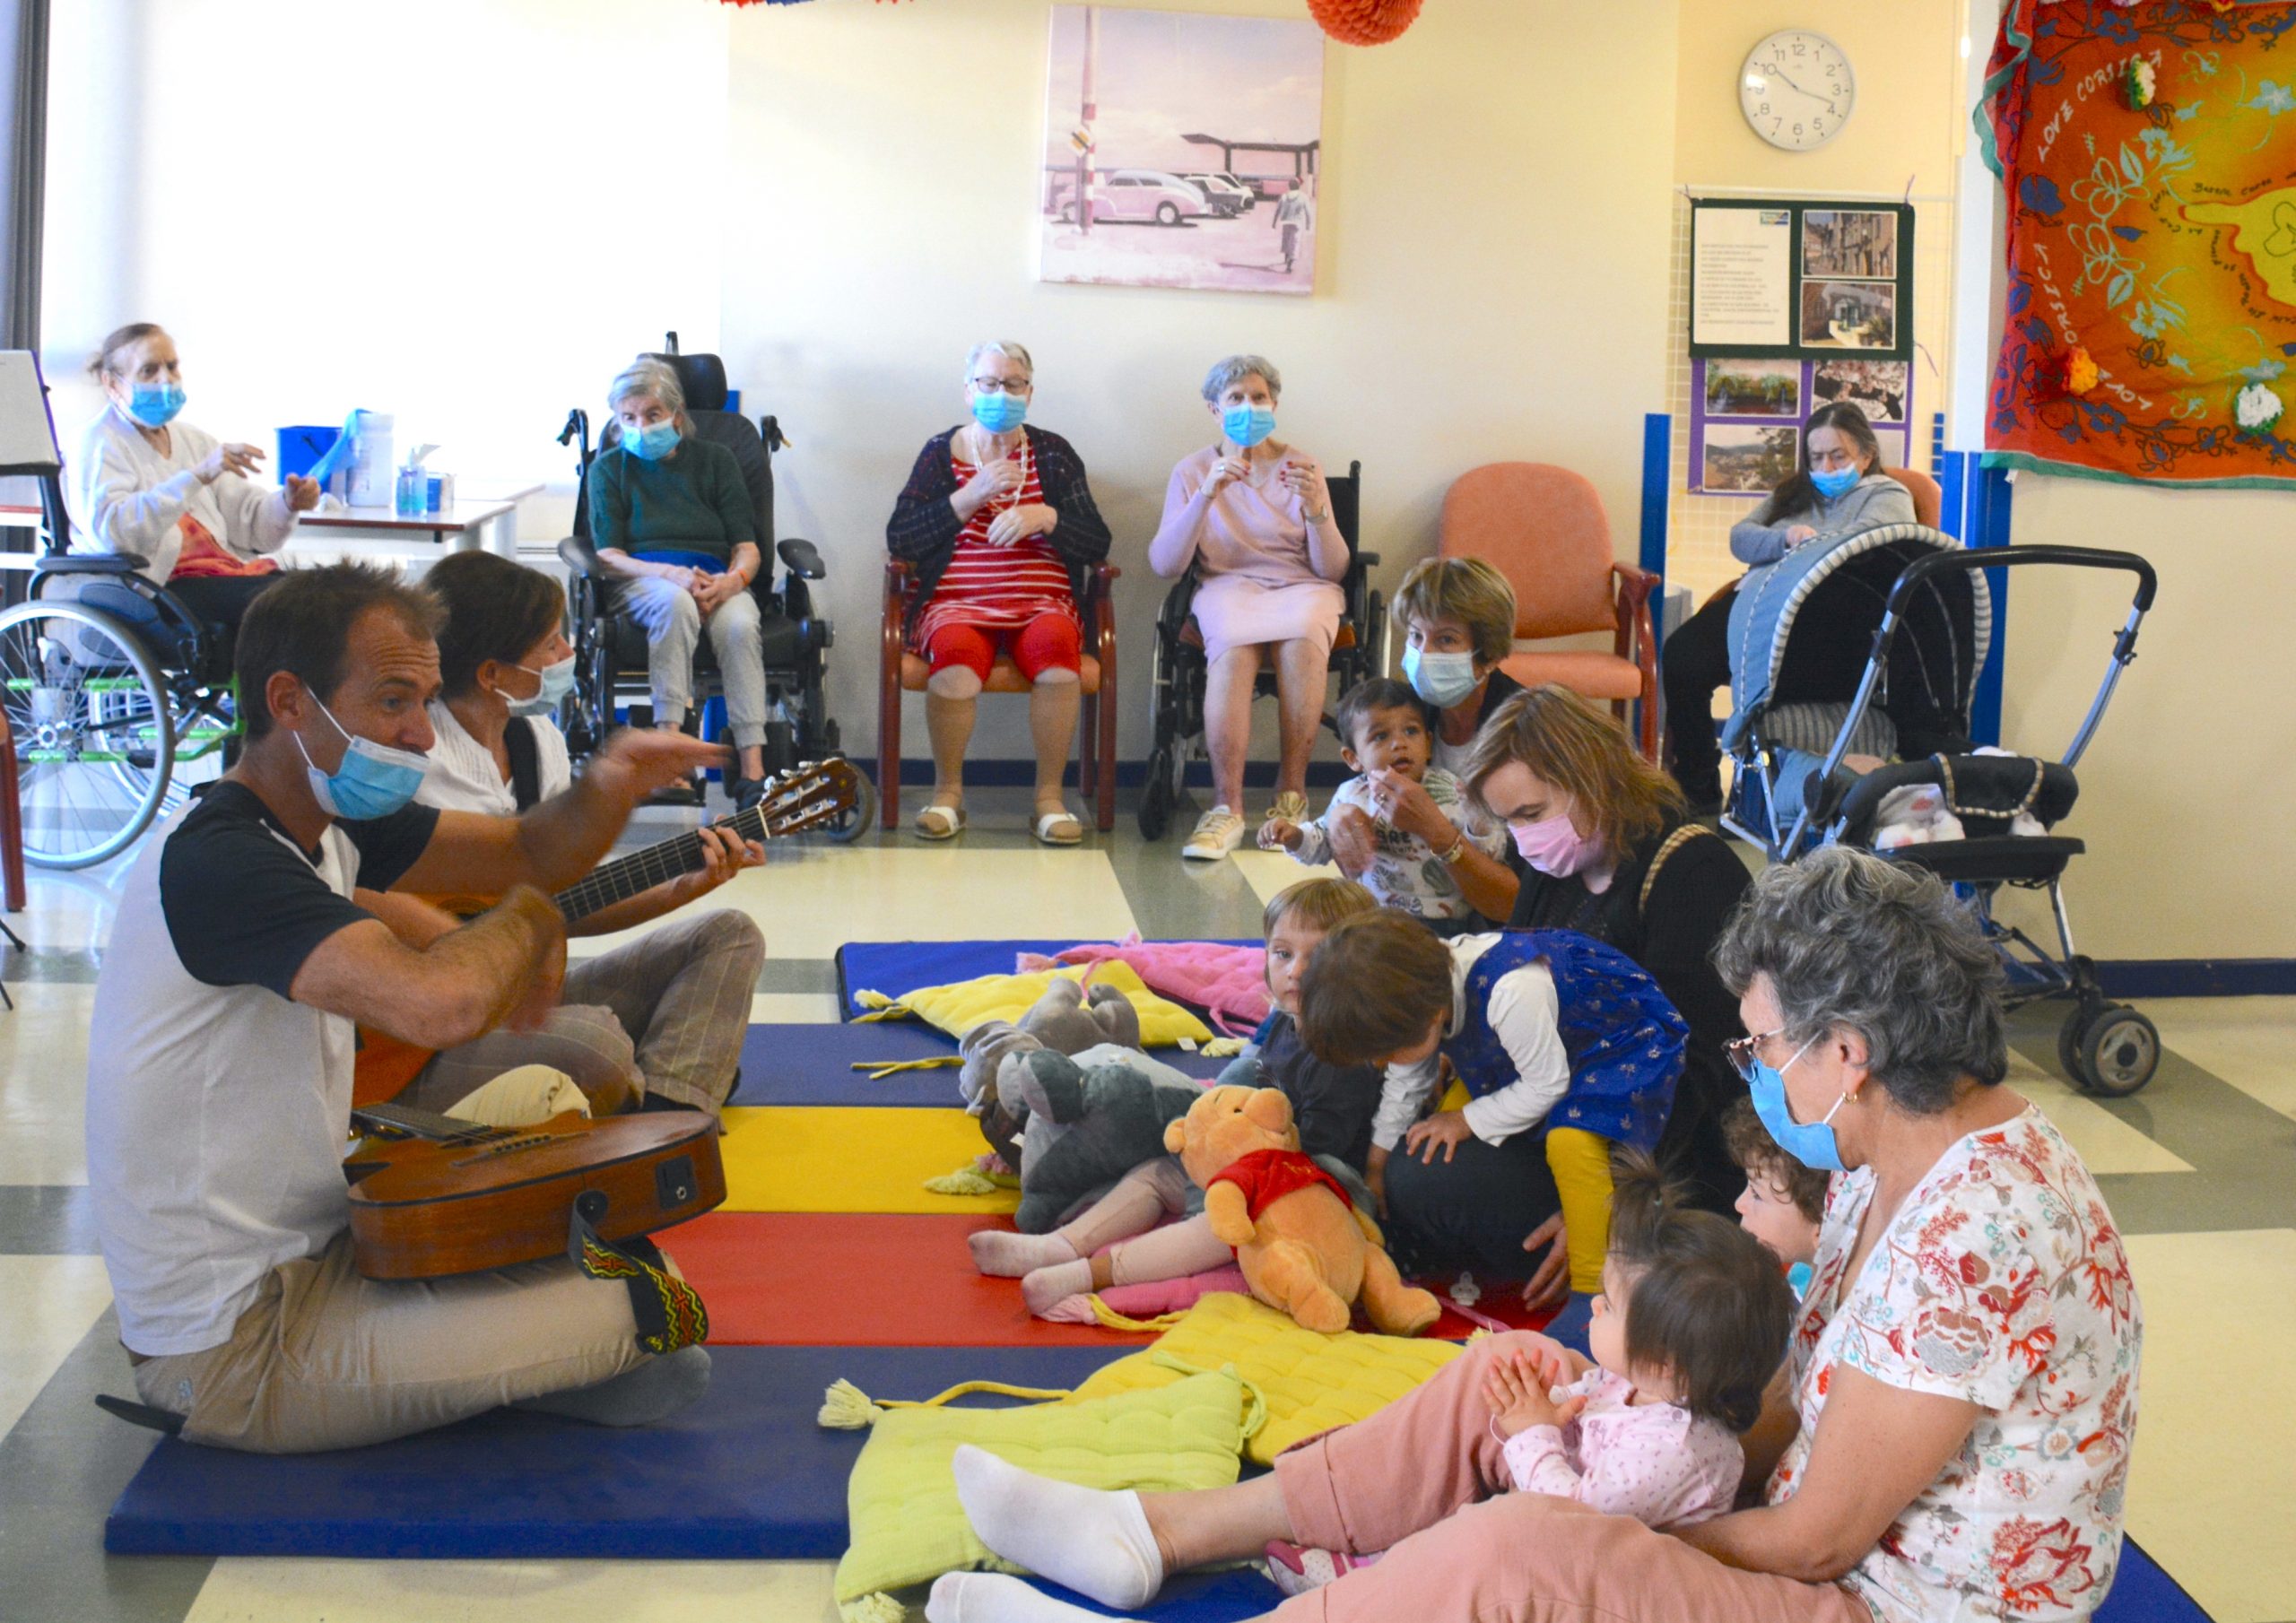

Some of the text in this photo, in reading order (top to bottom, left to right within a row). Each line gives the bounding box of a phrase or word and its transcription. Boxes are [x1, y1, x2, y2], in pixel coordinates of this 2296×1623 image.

[1774, 49, 1786, 61] 11
[1792, 44, 1805, 56] 12
[1813, 50, 1820, 62] 1
[1761, 63, 1777, 75] 10
[1826, 64, 1836, 77] 2
[1832, 83, 1841, 96] 3
[1760, 103, 1770, 115] 8
[1827, 101, 1835, 114] 4
[1774, 117, 1782, 129] 7
[1793, 123, 1803, 135] 6
[1813, 117, 1822, 130] 5
